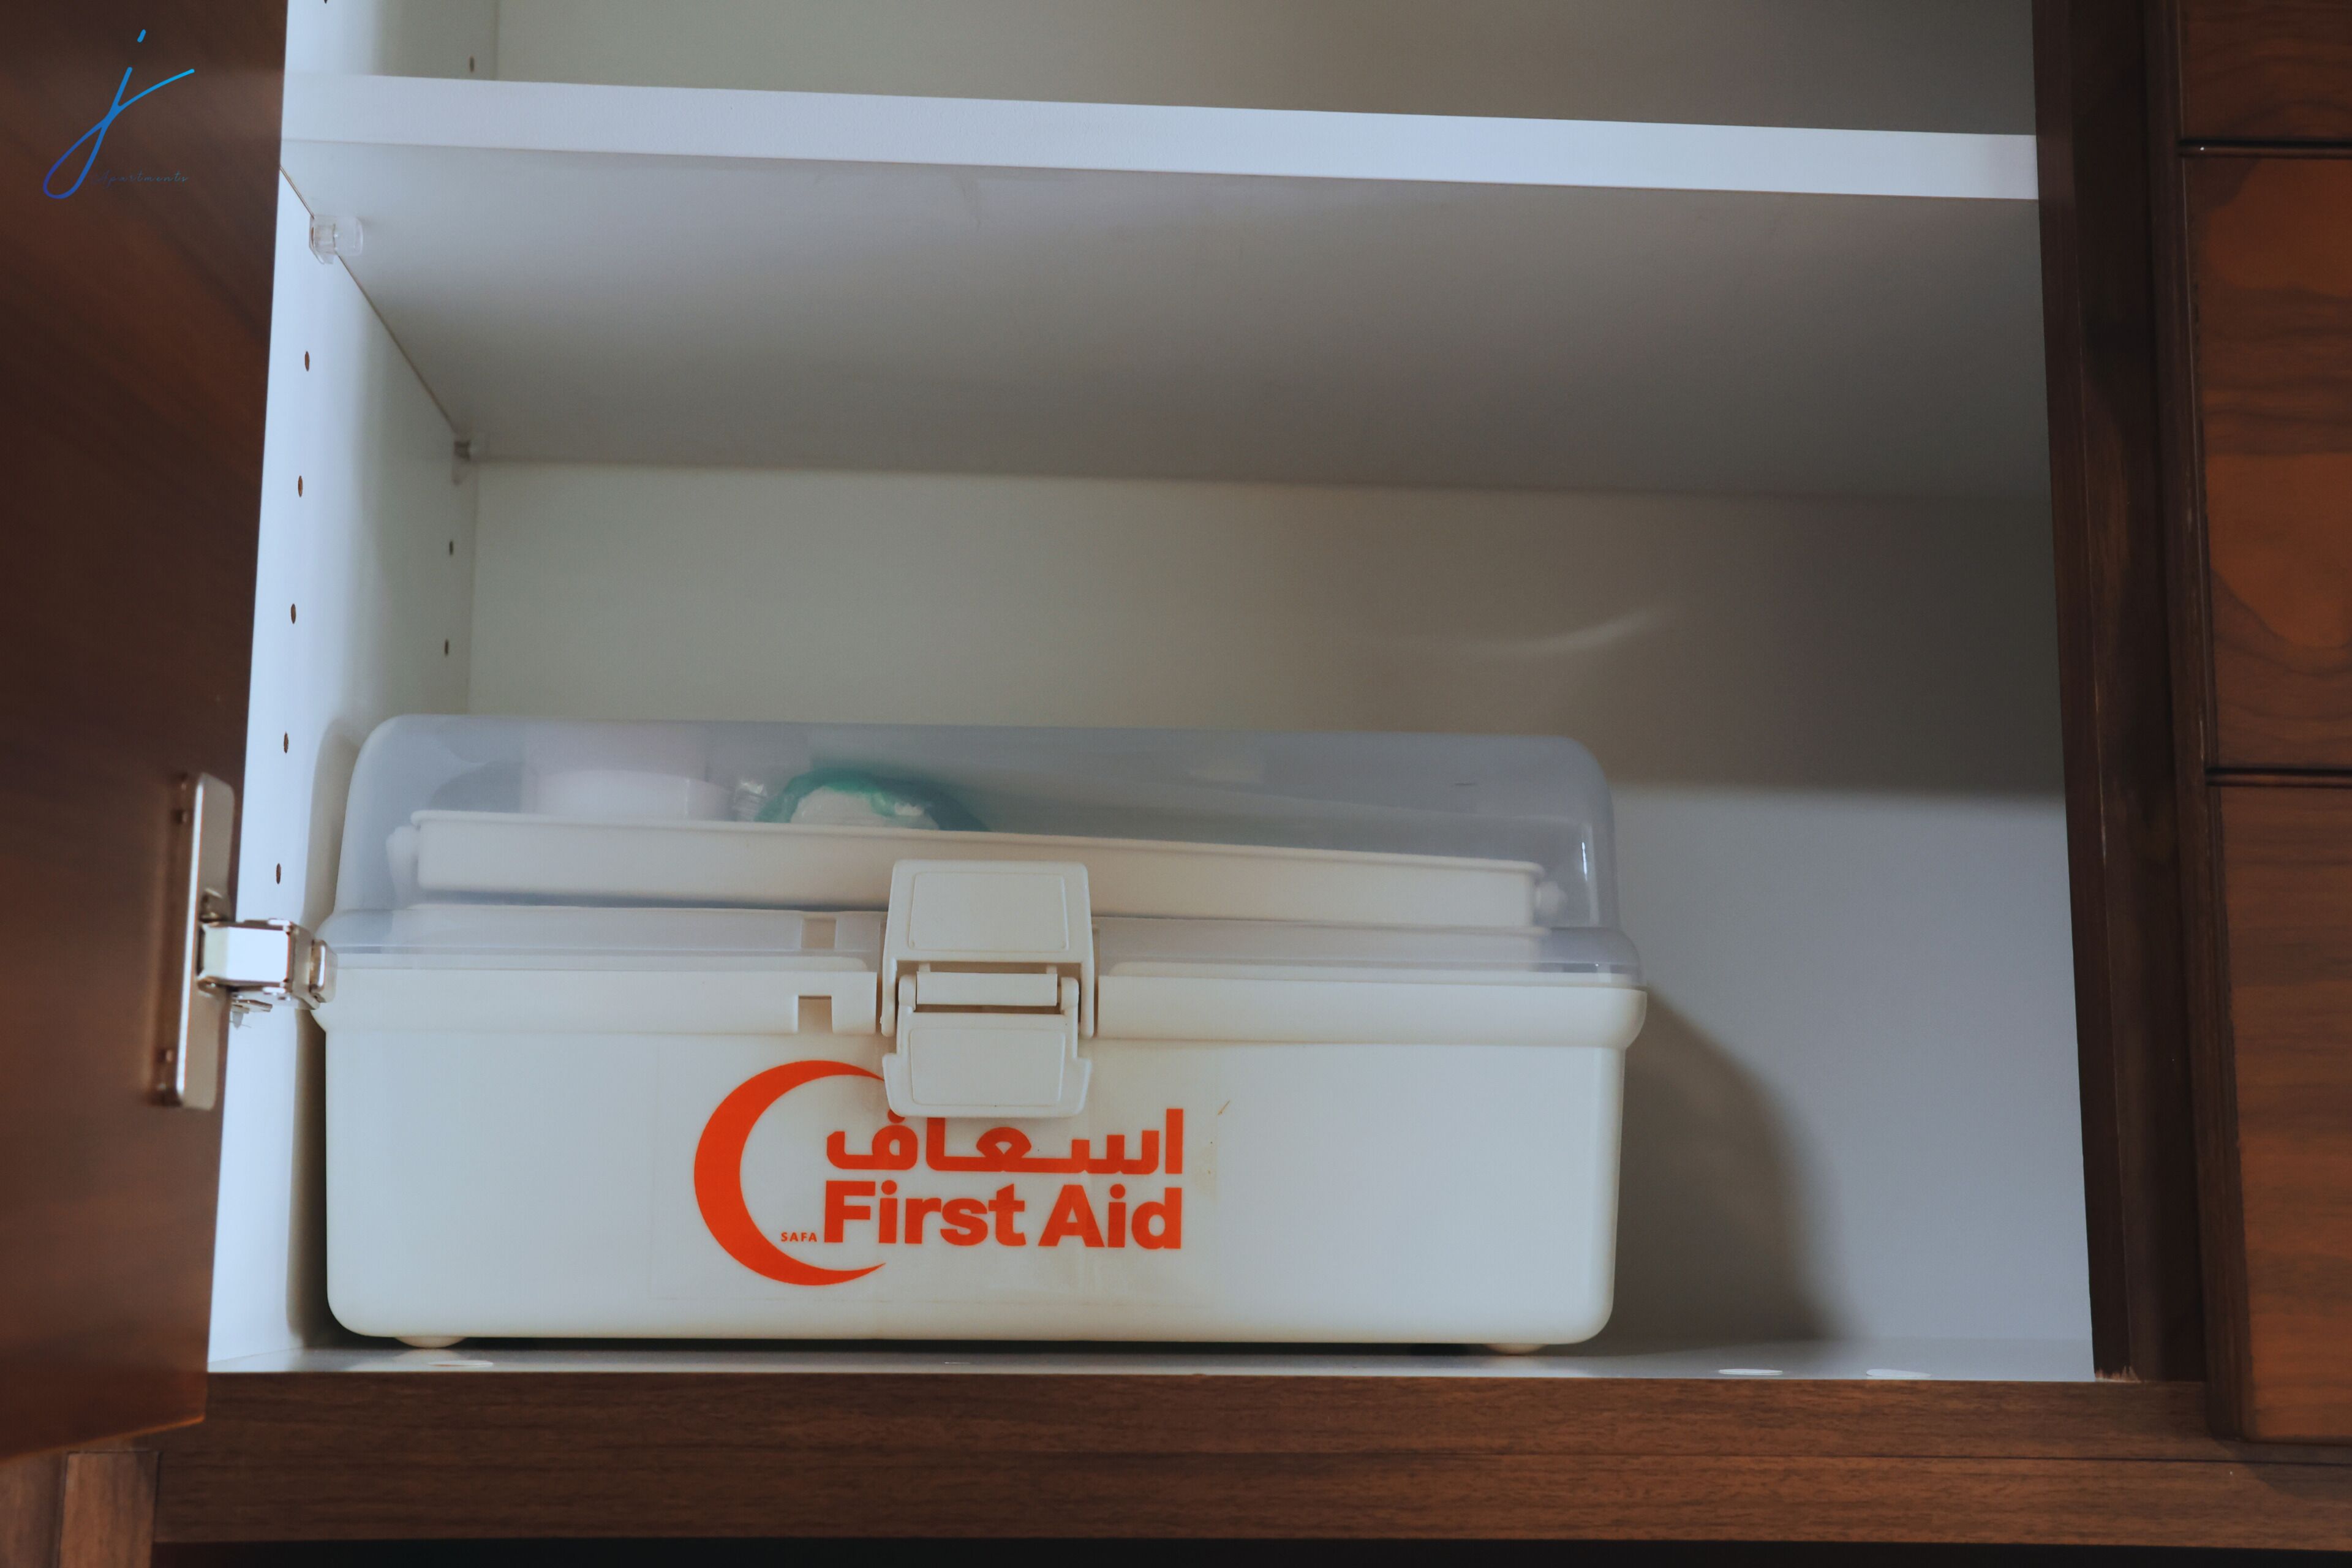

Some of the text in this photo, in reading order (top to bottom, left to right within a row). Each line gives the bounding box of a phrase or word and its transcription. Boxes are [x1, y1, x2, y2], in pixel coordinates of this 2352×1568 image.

[823, 1179, 1183, 1250] First Aid
[780, 1231, 818, 1243] SAFA
